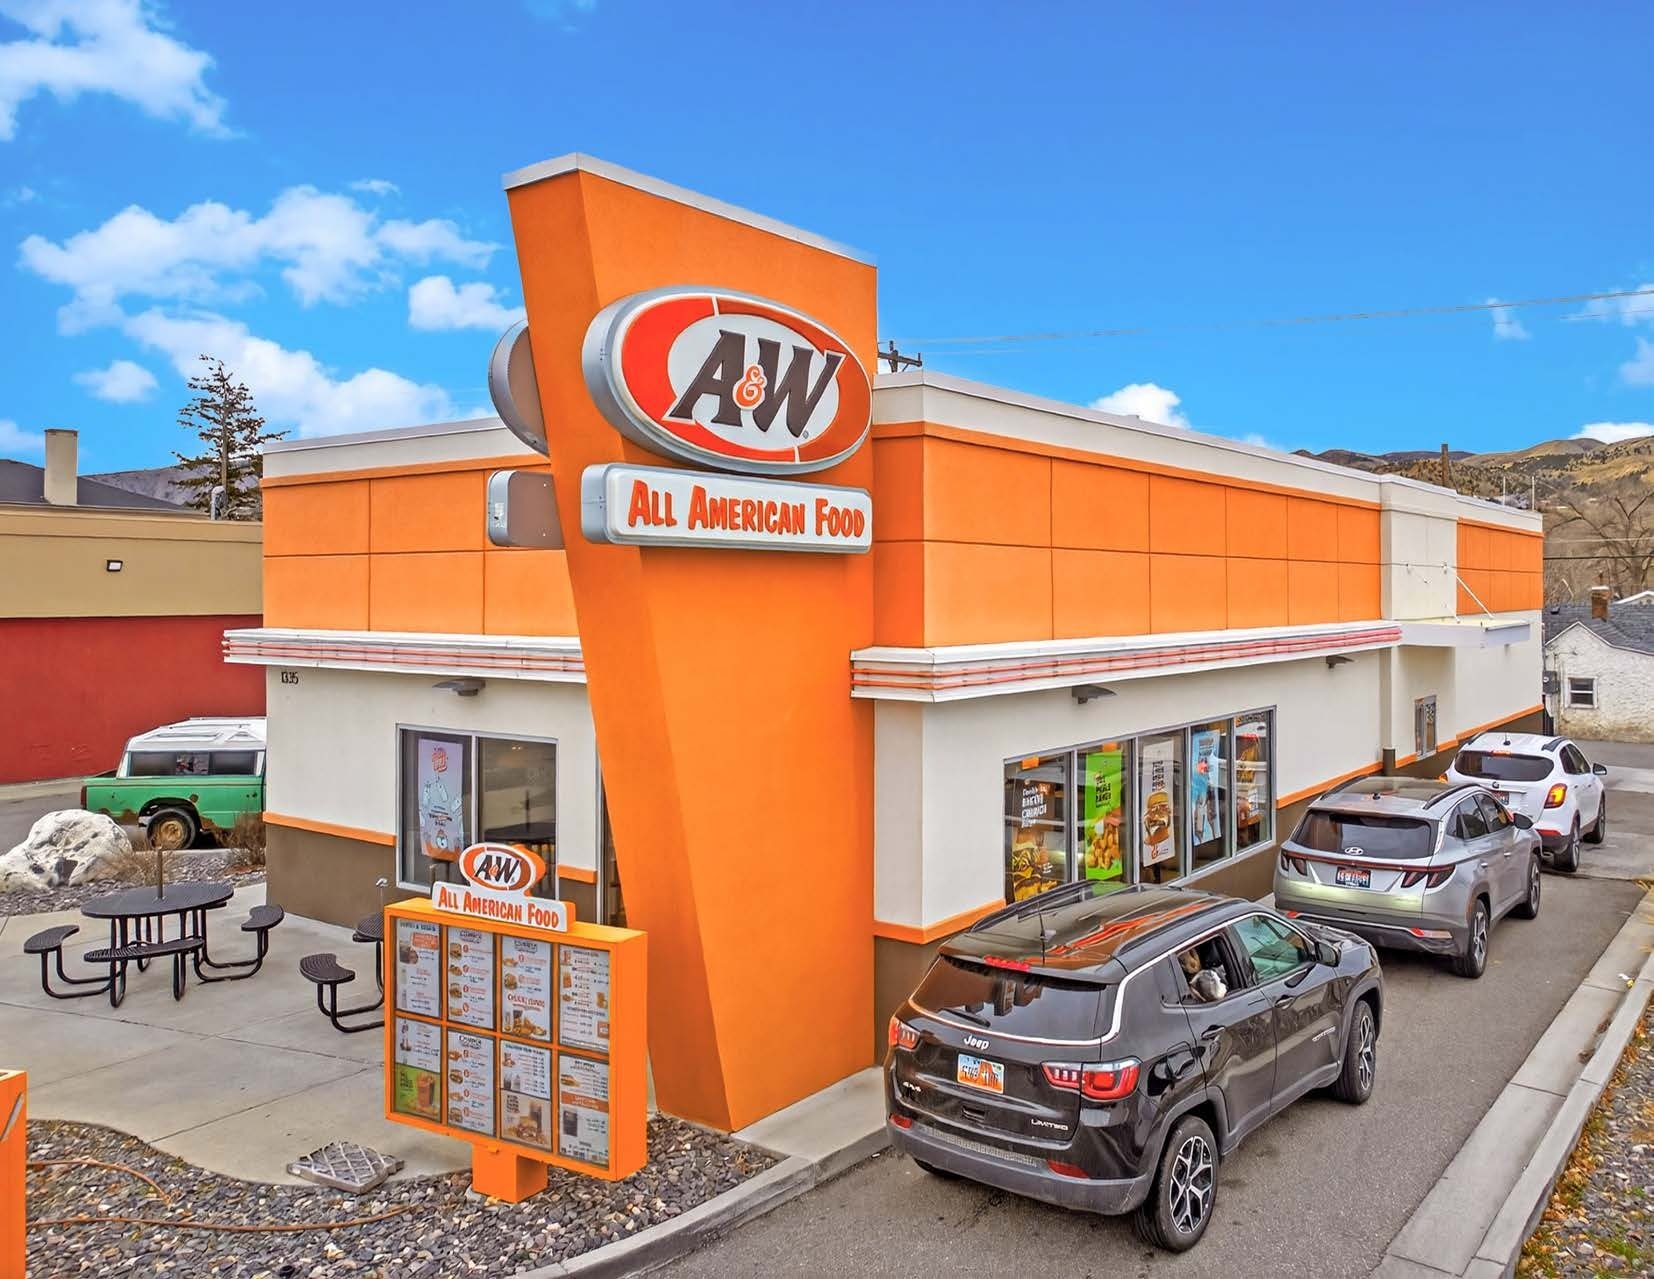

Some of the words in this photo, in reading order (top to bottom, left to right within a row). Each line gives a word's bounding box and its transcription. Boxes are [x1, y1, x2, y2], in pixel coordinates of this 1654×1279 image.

[669, 329, 843, 438] A&W
[628, 479, 677, 527] ALL
[688, 484, 805, 535] AMERICAN
[815, 497, 865, 538] FOOD
[474, 854, 520, 883] A&W
[438, 886, 458, 910] ALL
[463, 891, 523, 922] AMERICAN
[527, 903, 560, 928] FOOD
[963, 1034, 990, 1050] Jeep
